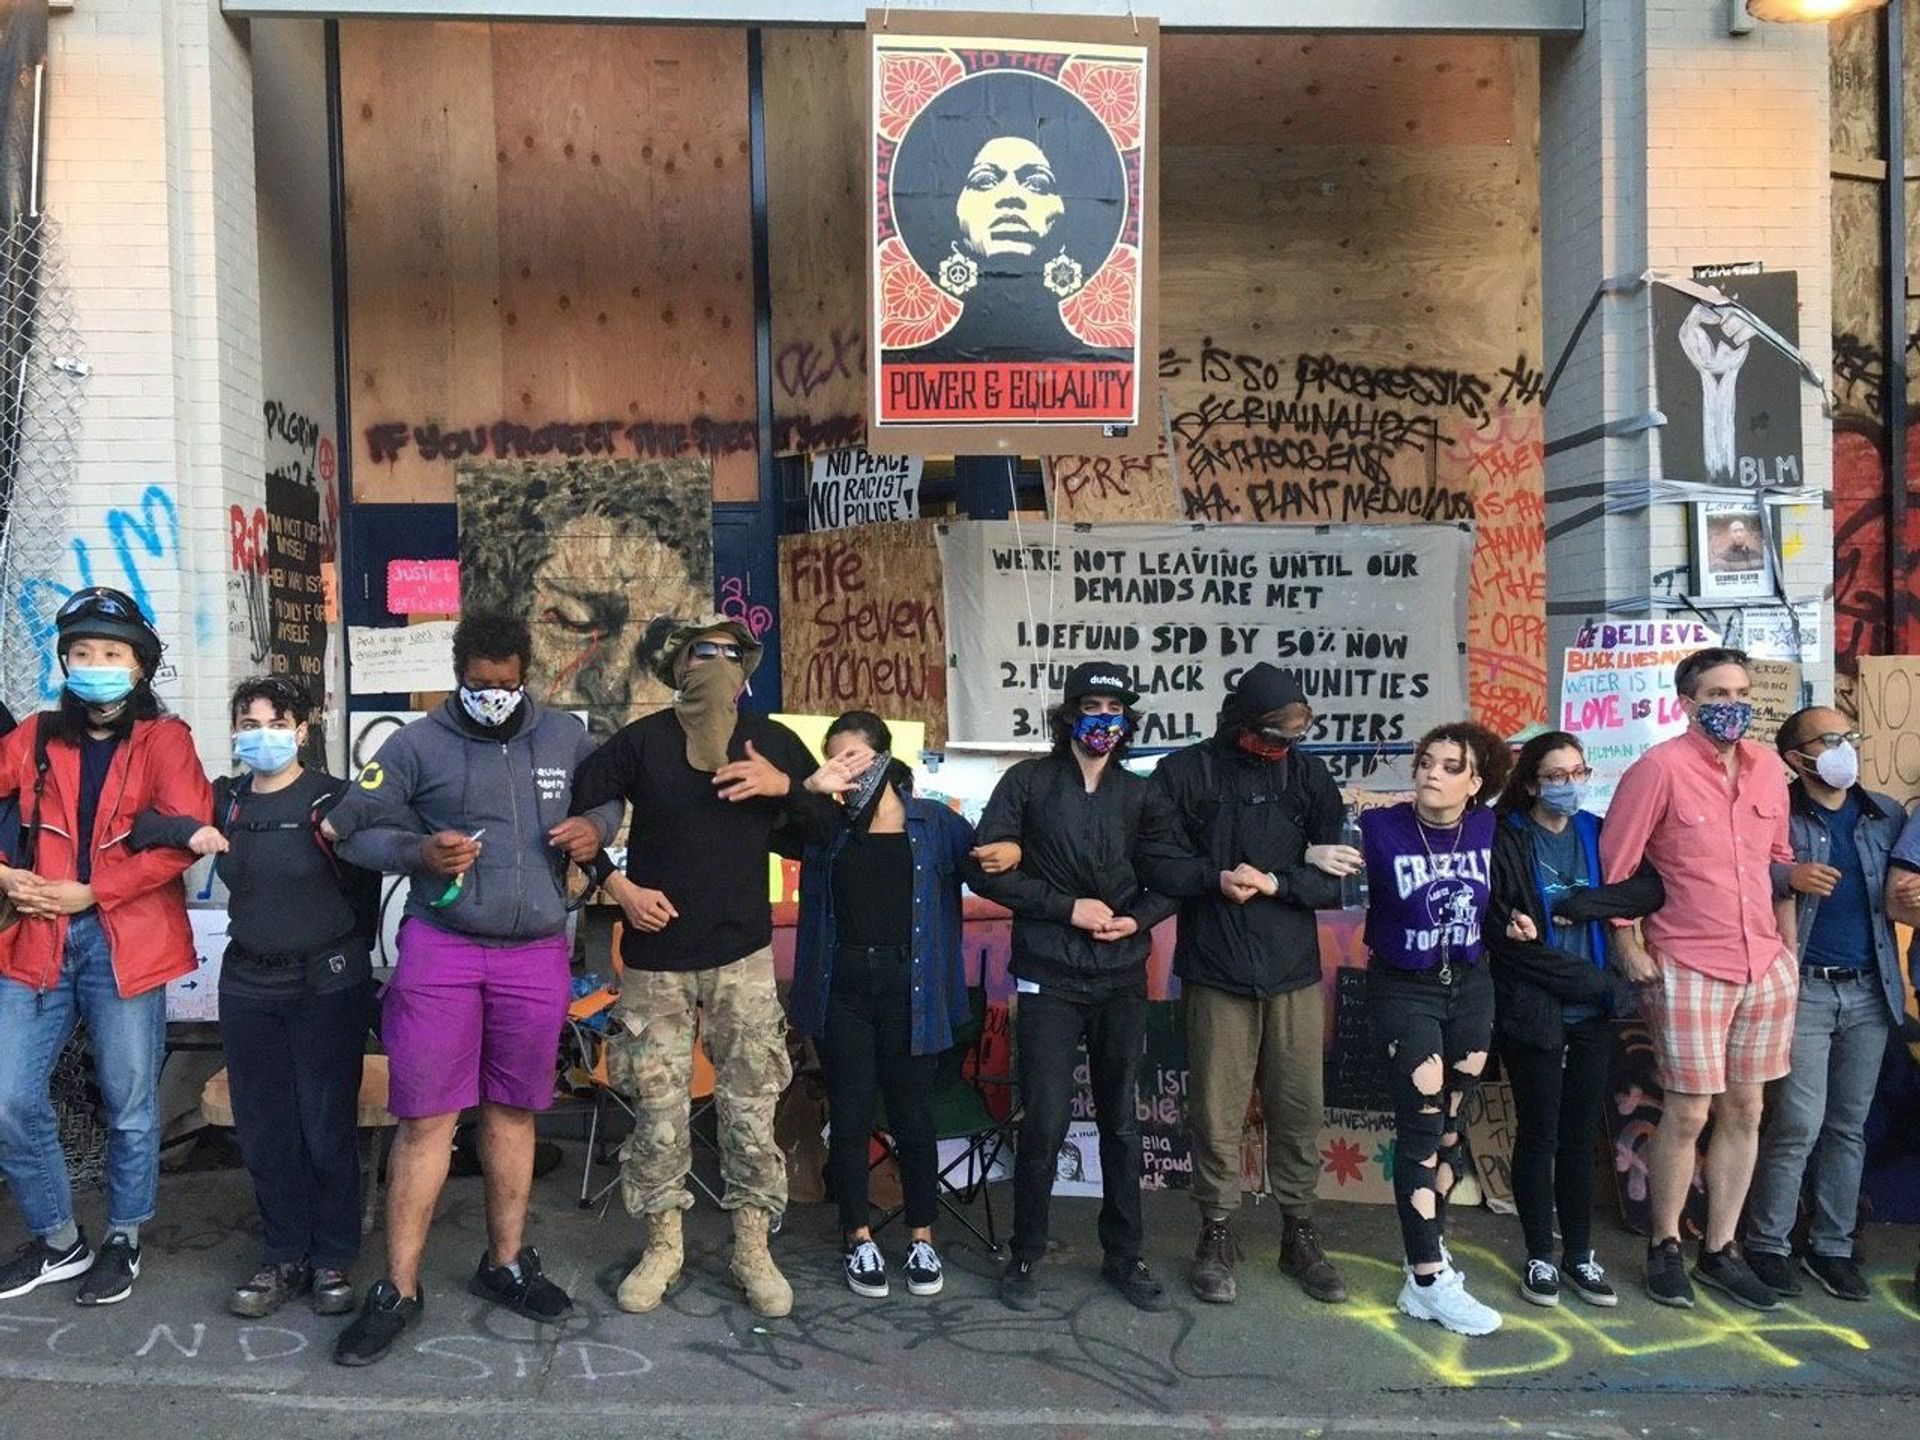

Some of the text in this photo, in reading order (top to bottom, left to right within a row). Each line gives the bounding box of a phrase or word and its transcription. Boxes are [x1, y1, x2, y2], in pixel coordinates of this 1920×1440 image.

[1006, 52, 1062, 77] THE
[890, 369, 1132, 414] POWER & EQUALITY
[826, 452, 851, 476] NO
[1739, 455, 1799, 488] BLM
[810, 475, 908, 530] NO RACIST
[1248, 478, 1338, 522] PLANT
[789, 547, 865, 600] Fire
[992, 549, 1418, 578] WE'RE NOT LEAVING UNTIL OUR
[1075, 578, 1323, 609] DEMANDS ARE MET
[814, 597, 943, 648] Steven
[1602, 623, 1709, 649] BELIEVE
[1151, 626, 1207, 654] SPD
[1221, 627, 1260, 657] BY
[1277, 630, 1336, 658] 50%
[1346, 633, 1408, 659] NOW
[1001, 661, 1025, 688] 2.
[1567, 651, 1614, 673] BLACK
[1566, 672, 1620, 695] WATER
[1629, 671, 1646, 692] IS
[1013, 708, 1038, 737] 3.
[1142, 712, 1201, 744] ALL
[1564, 694, 1624, 732] LOVE
[1632, 699, 1651, 720] IS
[1143, 1151, 1194, 1173] Proud
